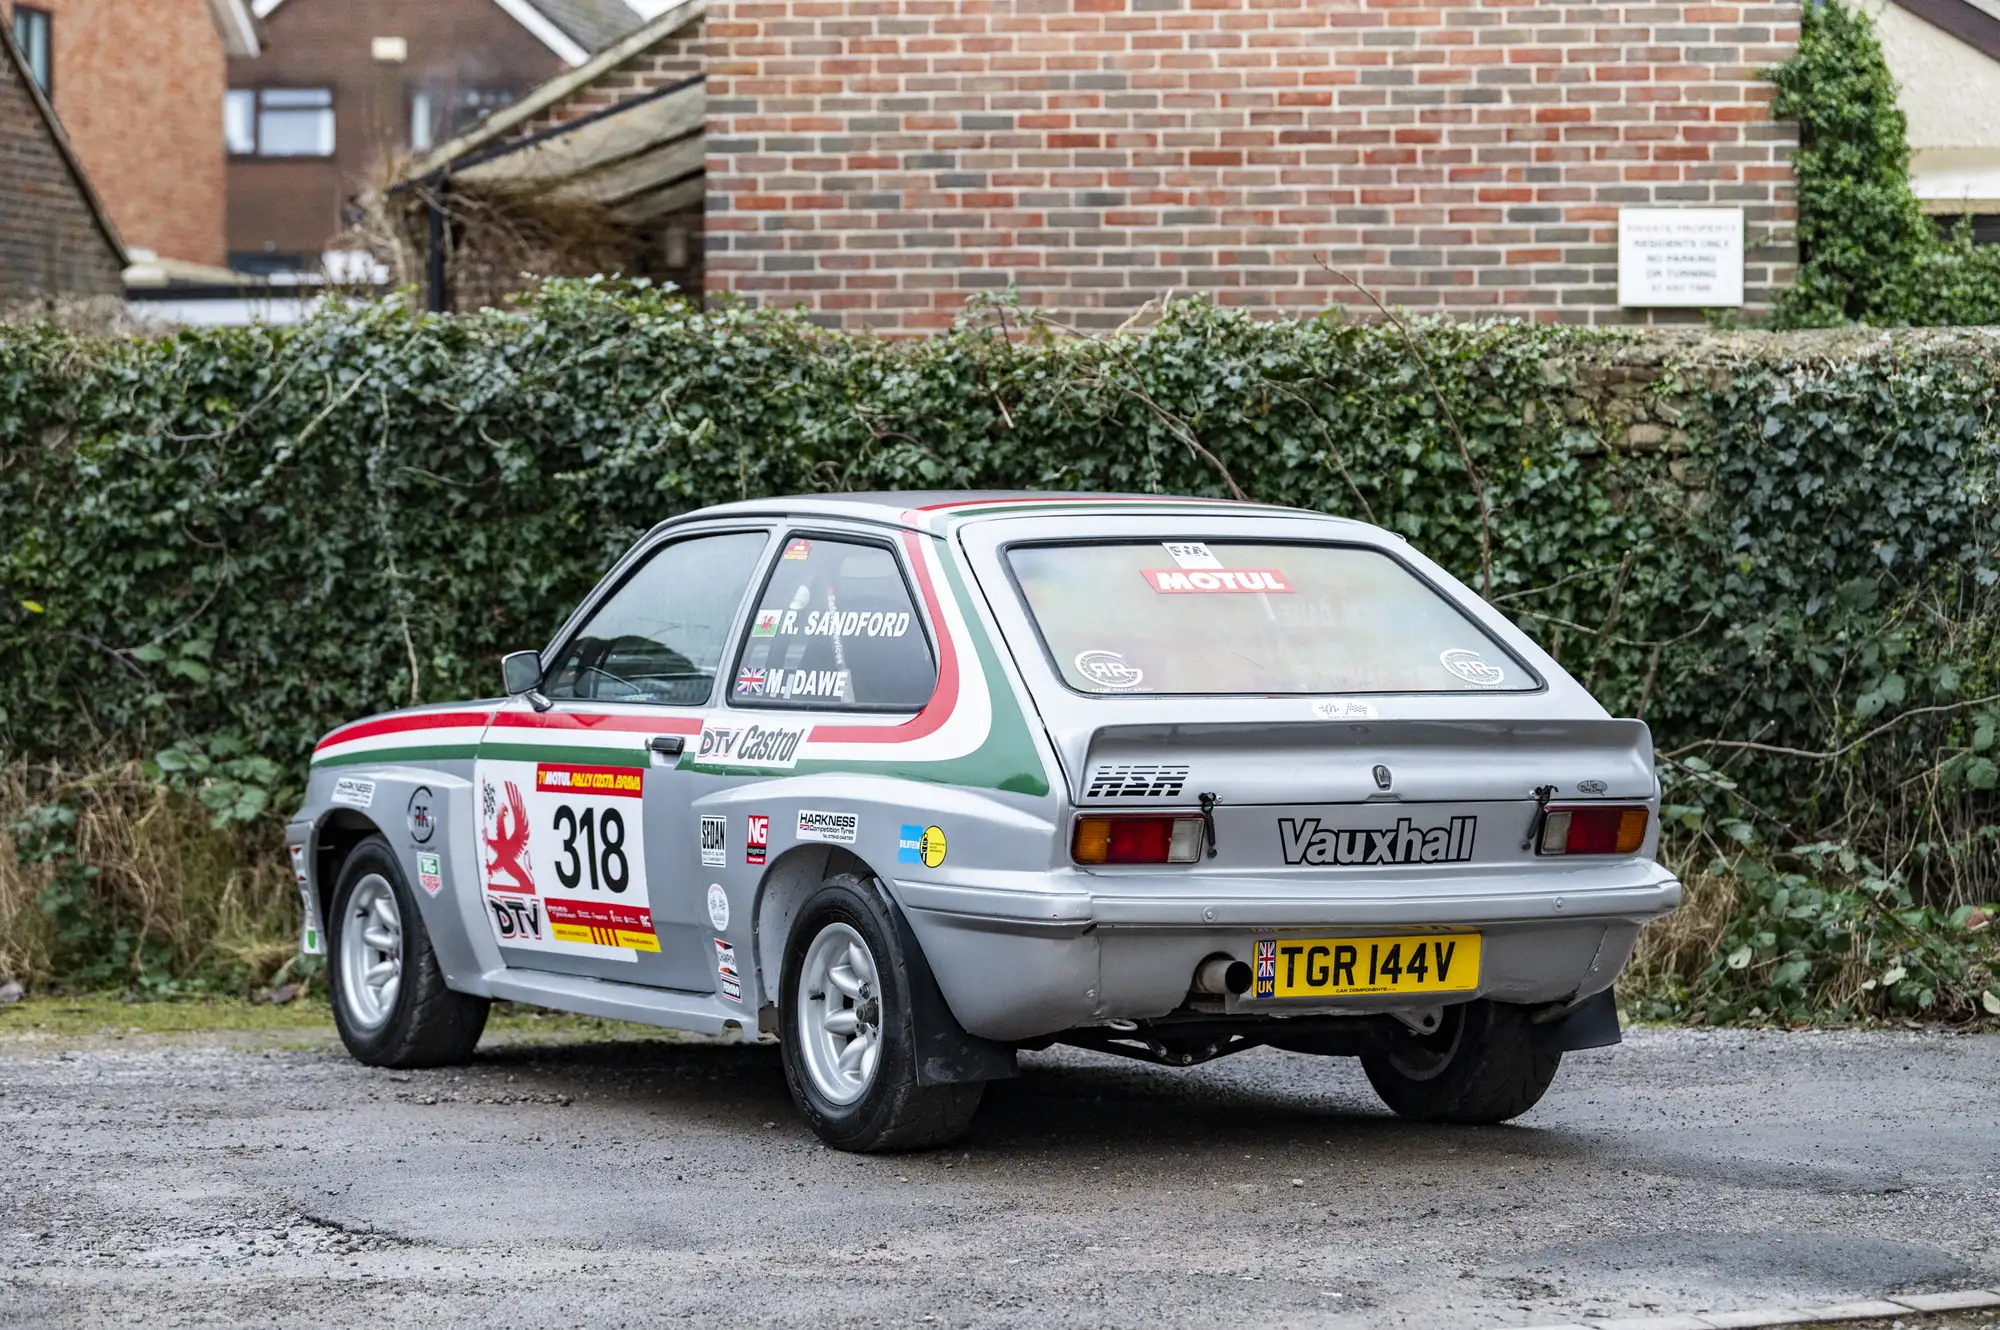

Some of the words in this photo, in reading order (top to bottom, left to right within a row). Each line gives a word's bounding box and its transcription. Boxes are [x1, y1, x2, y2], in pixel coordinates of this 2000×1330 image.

[1156, 571, 1287, 591] MOTUL
[780, 610, 799, 636] R.
[804, 611, 911, 638] SANDFORD
[765, 669, 787, 694] M.
[792, 669, 849, 697] DAWE
[697, 727, 744, 757] DTV
[737, 724, 806, 762] Castrol
[545, 771, 571, 786] MOTUL
[592, 773, 615, 789] COSTA
[748, 817, 768, 844] NG
[800, 812, 856, 828] HARKNESS
[810, 825, 839, 834] Competition
[840, 827, 855, 835] Tyres
[553, 804, 629, 893] 318
[702, 820, 725, 850] SEDAN
[1278, 815, 1477, 866] Vauxhall
[489, 898, 542, 940] DTV
[1280, 945, 1358, 988] TGR
[1368, 941, 1456, 985] 144V
[1257, 980, 1274, 994] UK
